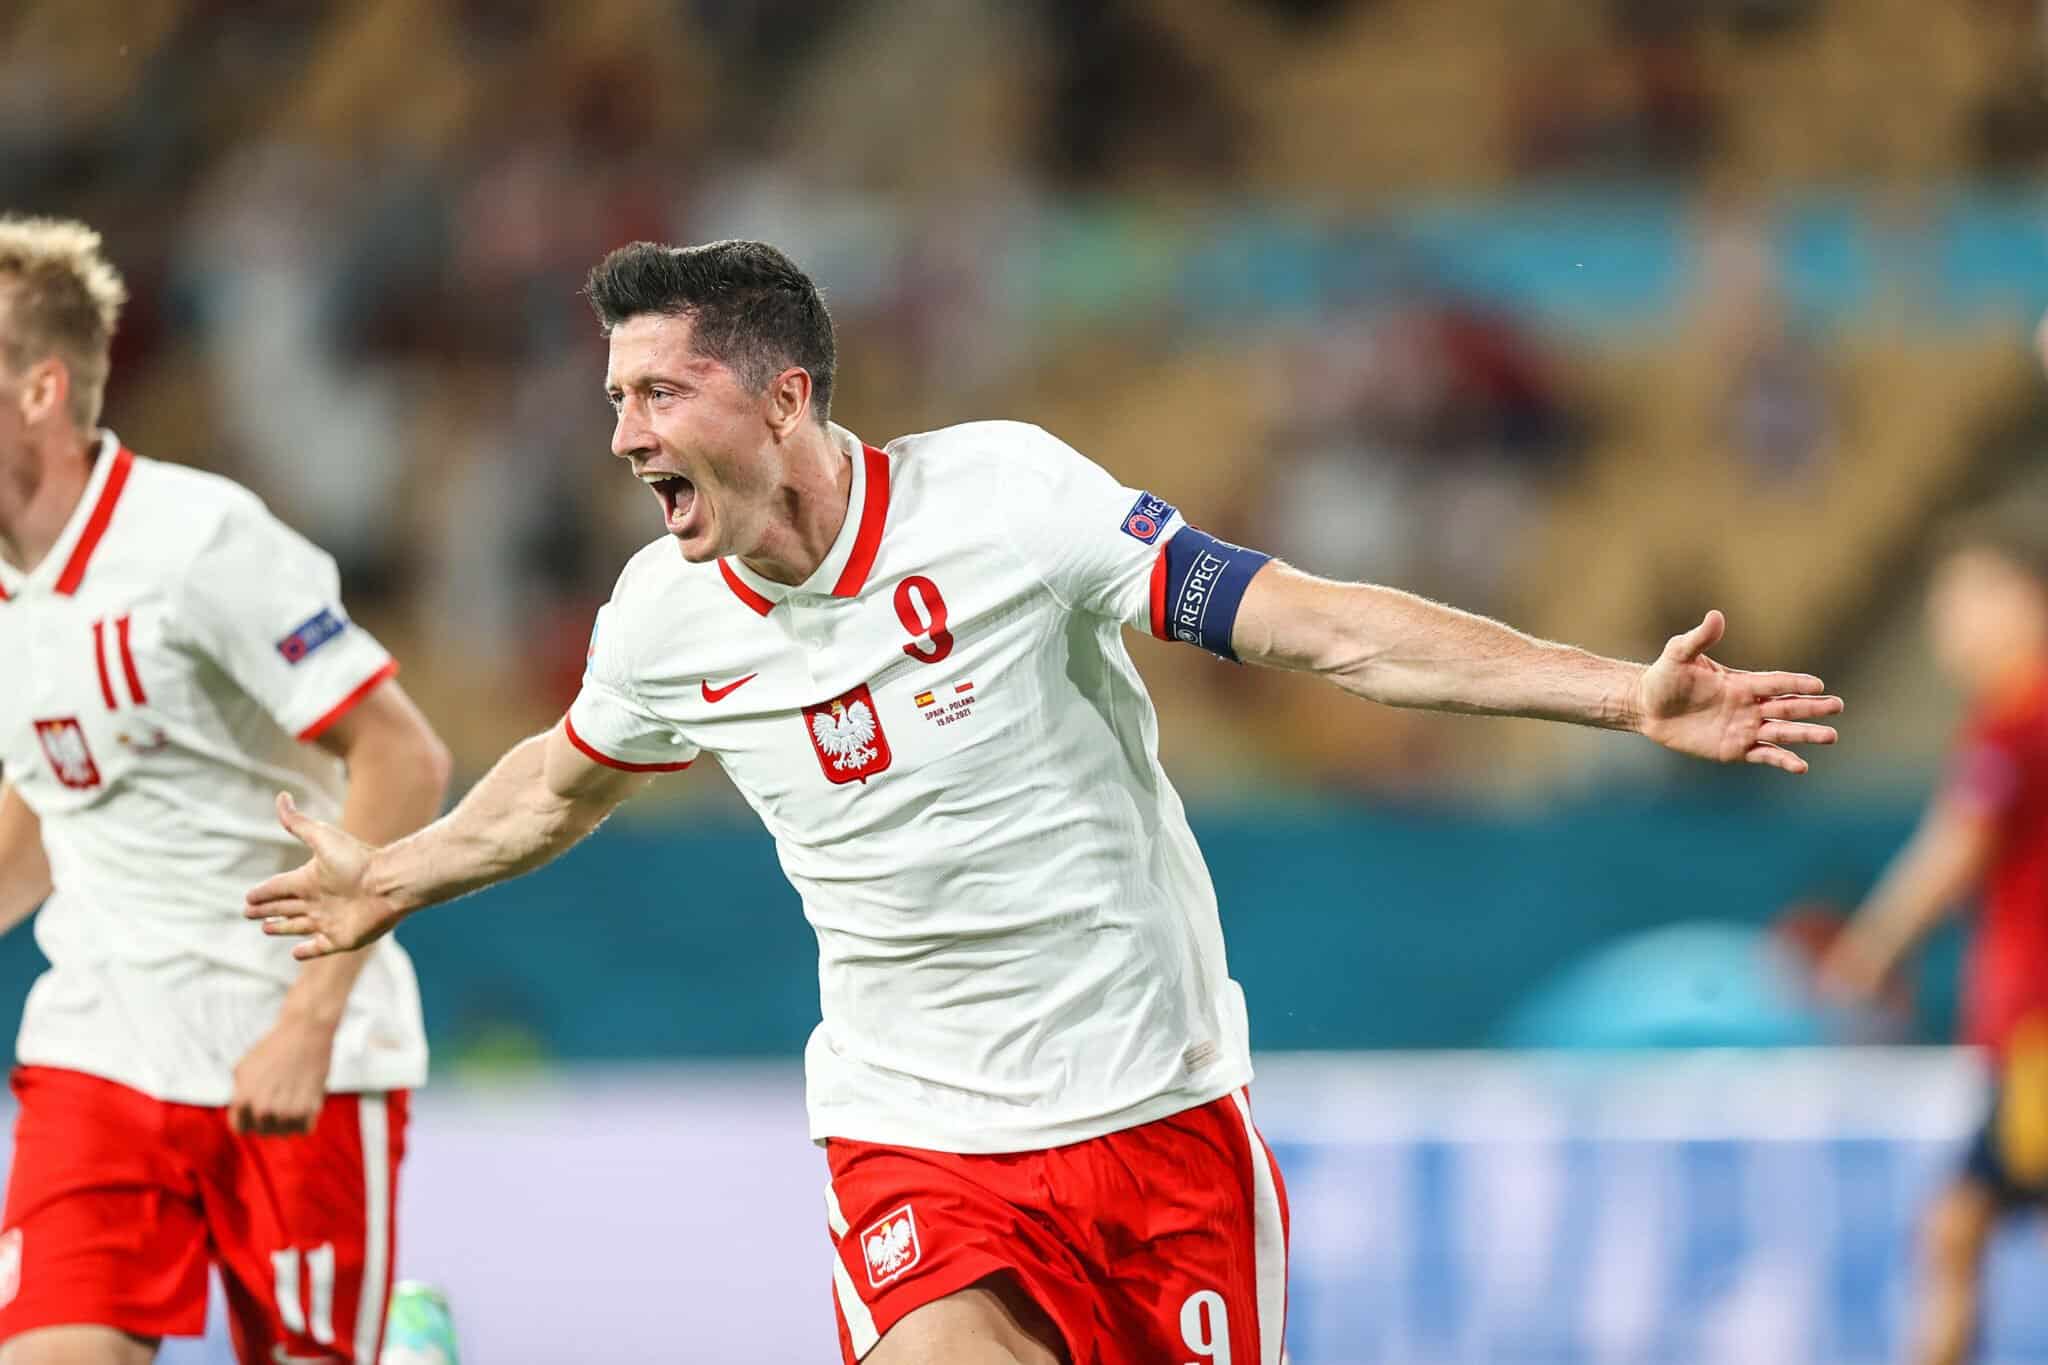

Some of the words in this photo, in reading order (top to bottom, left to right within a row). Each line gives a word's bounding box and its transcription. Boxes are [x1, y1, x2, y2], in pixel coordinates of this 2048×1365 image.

[893, 575, 954, 664] 9
[1180, 553, 1222, 627] RESPECT
[93, 613, 147, 711] 11
[925, 707, 945, 720] SPAIN
[949, 696, 975, 711] POLAND
[271, 1242, 335, 1344] 11
[1180, 1289, 1232, 1365] 9
